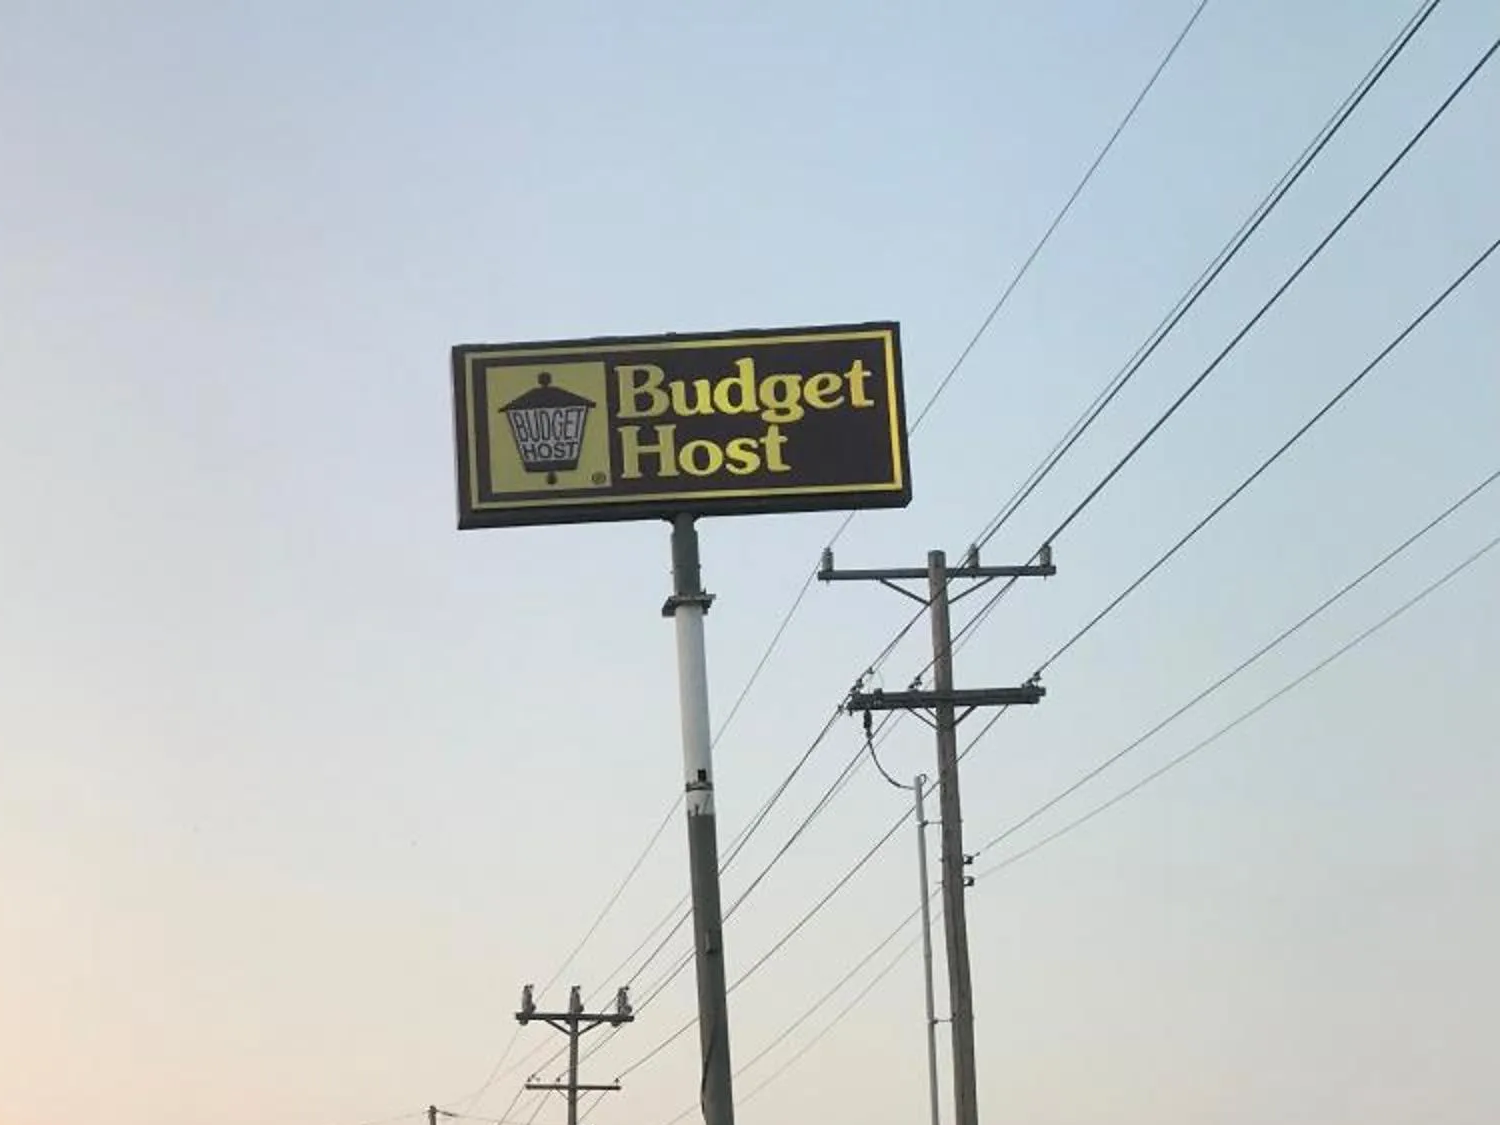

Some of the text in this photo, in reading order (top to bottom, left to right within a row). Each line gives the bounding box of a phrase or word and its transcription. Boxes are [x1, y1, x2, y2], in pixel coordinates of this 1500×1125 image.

[613, 357, 875, 423] Budget
[512, 407, 585, 442] BUDGET
[521, 441, 579, 461] HOST
[617, 422, 791, 480] Host
